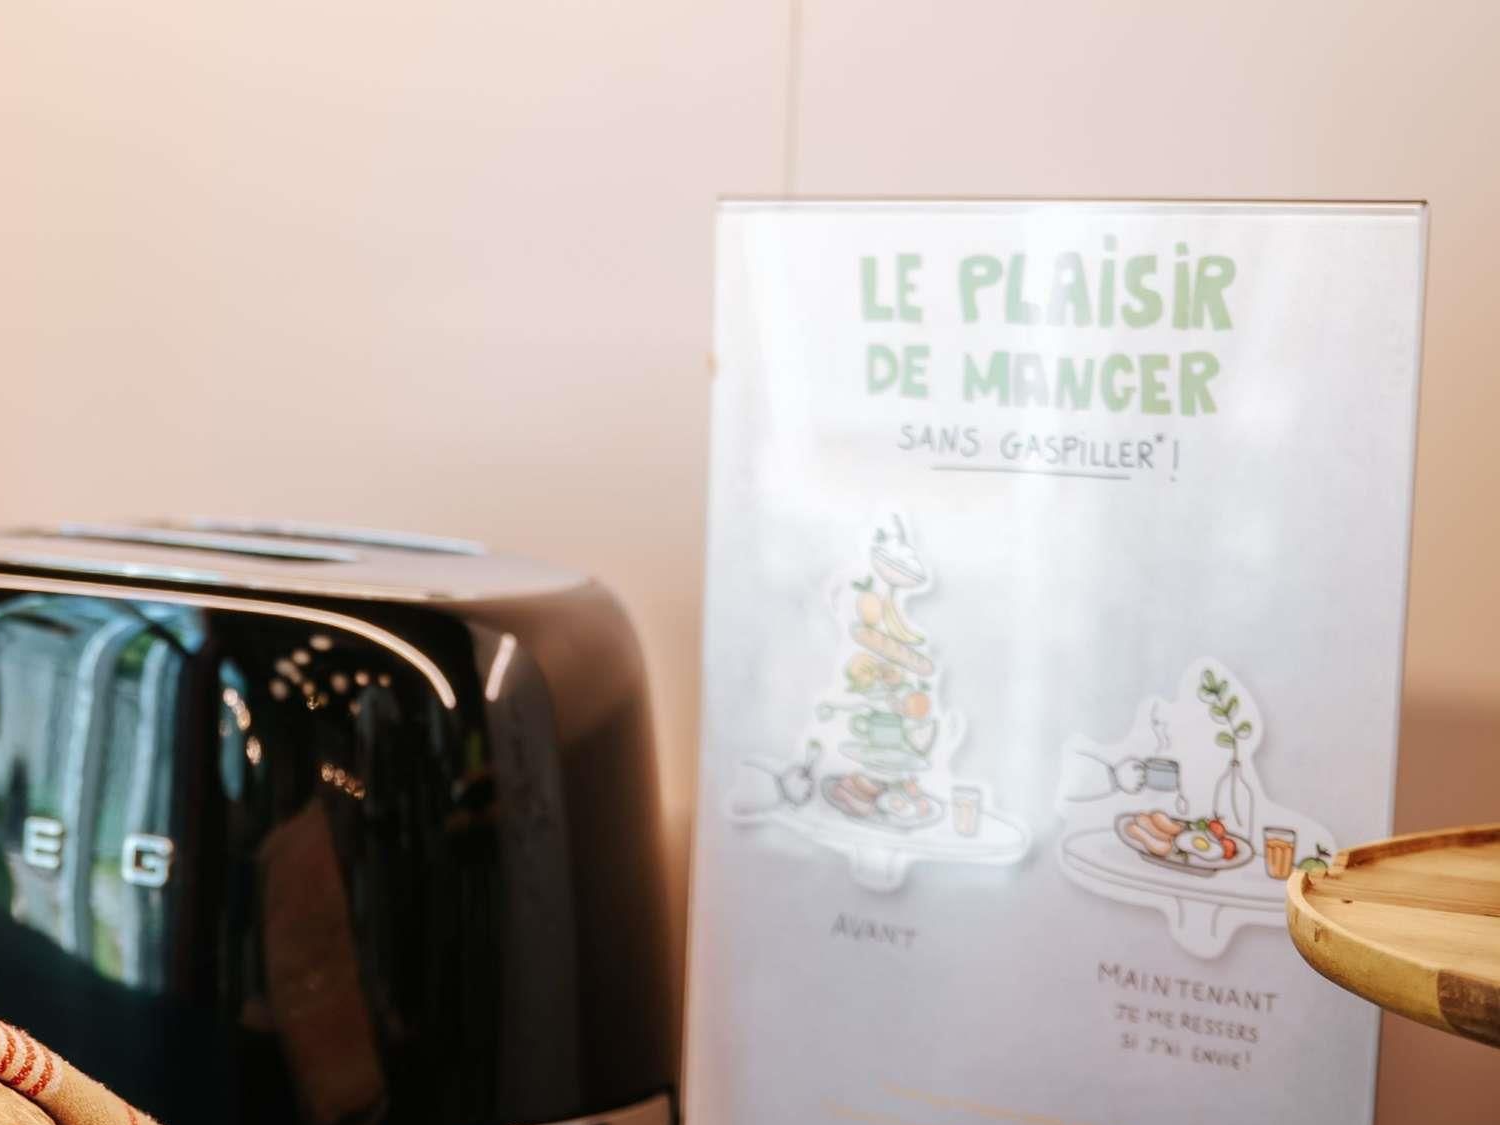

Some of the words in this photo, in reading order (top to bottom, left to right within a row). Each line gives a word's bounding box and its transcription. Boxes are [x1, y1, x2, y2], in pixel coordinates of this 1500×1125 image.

[858, 252, 925, 325] LE
[865, 341, 932, 400] DE
[961, 349, 1222, 418] MANGER
[897, 423, 981, 459] SANS
[829, 911, 919, 952] AVANT
[1097, 961, 1280, 1014] MAINTENANT
[1179, 1011, 1260, 1045] RESSERS
